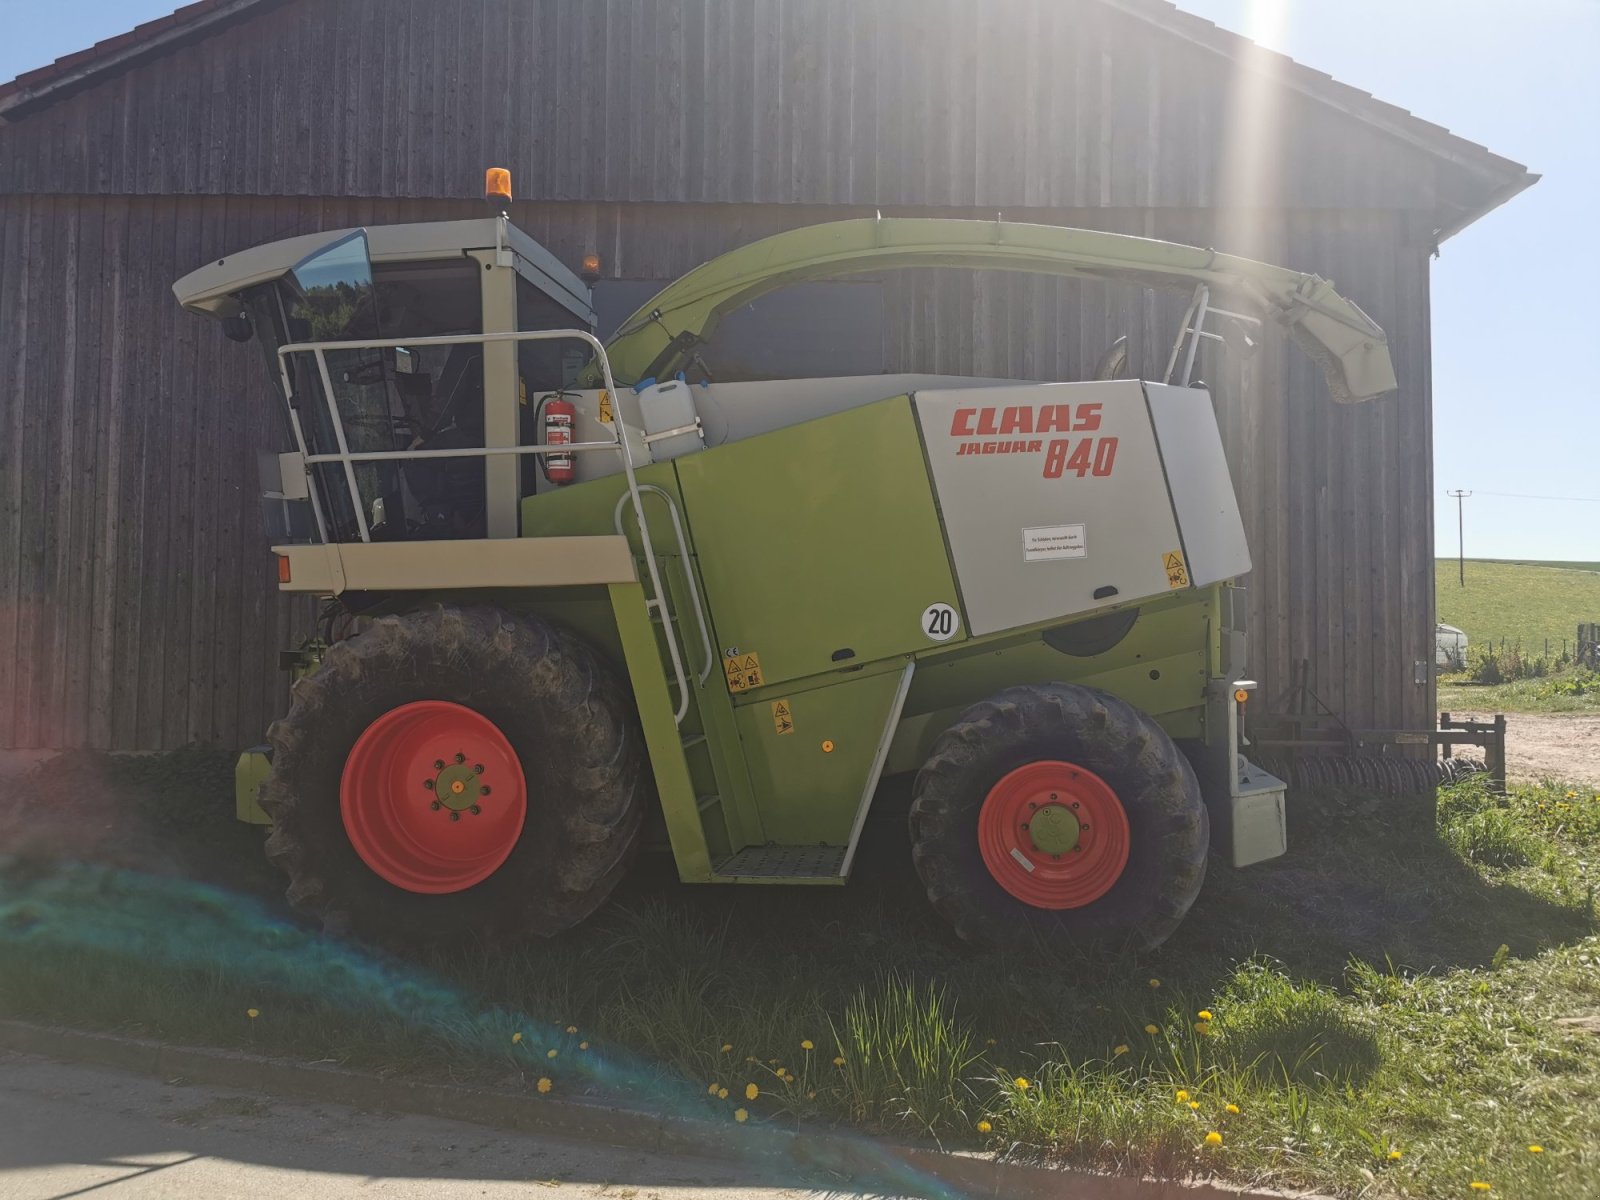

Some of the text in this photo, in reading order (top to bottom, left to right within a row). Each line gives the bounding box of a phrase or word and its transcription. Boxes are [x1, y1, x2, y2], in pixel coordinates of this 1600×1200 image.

[950, 403, 1103, 436] CLAAS
[956, 437, 1119, 479] JAGUAR 840
[928, 609, 952, 635] 20
